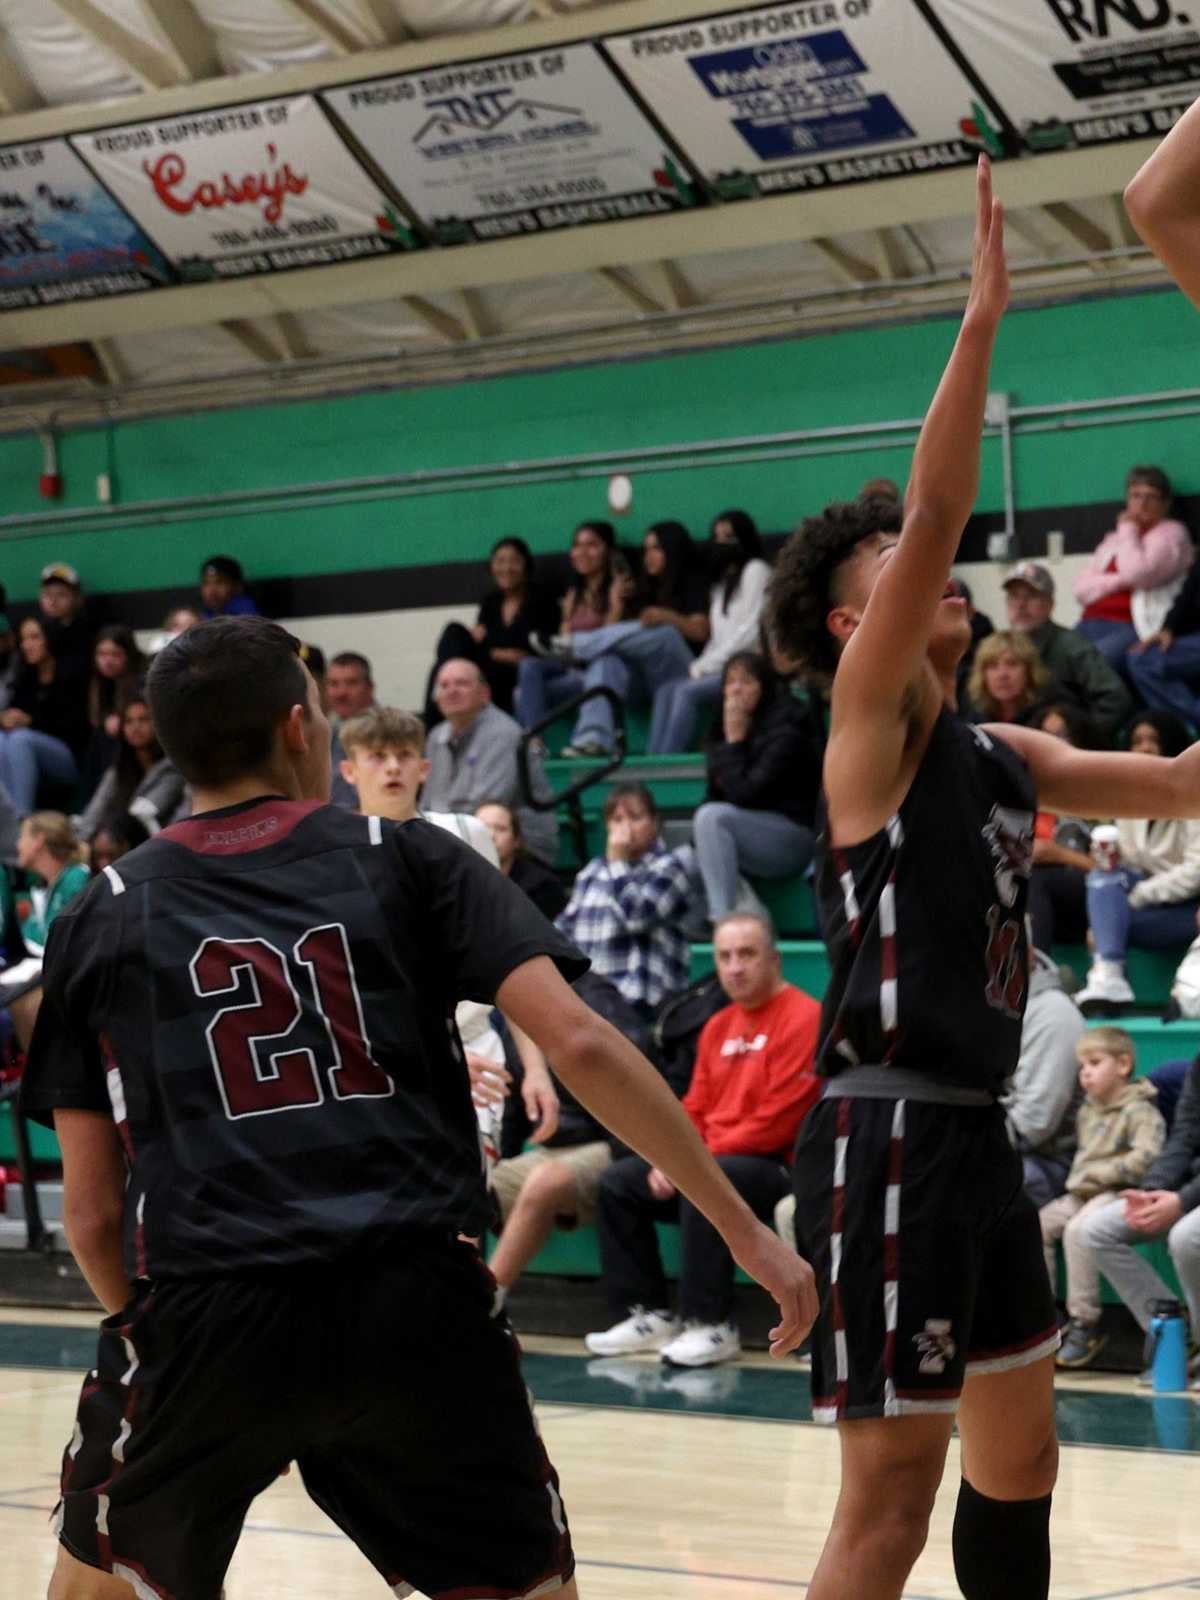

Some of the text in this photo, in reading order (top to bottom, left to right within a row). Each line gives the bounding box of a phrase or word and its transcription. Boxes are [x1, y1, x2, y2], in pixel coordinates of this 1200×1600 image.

[631, 32, 703, 56] PROUD
[708, 4, 838, 44] SUPPORTER
[351, 54, 566, 106] PROUD SUPPORTER OF
[95, 105, 290, 152] PROUD SUPPORTER OF
[1073, 115, 1149, 140] MEN'S
[143, 141, 308, 224] Casey's
[757, 145, 974, 190] MEN'S BASKETBALL
[472, 212, 538, 239] MEN'S
[539, 191, 674, 227] BASKETBALL
[271, 236, 388, 268] BASKETBALL
[188, 922, 395, 1121] 21
